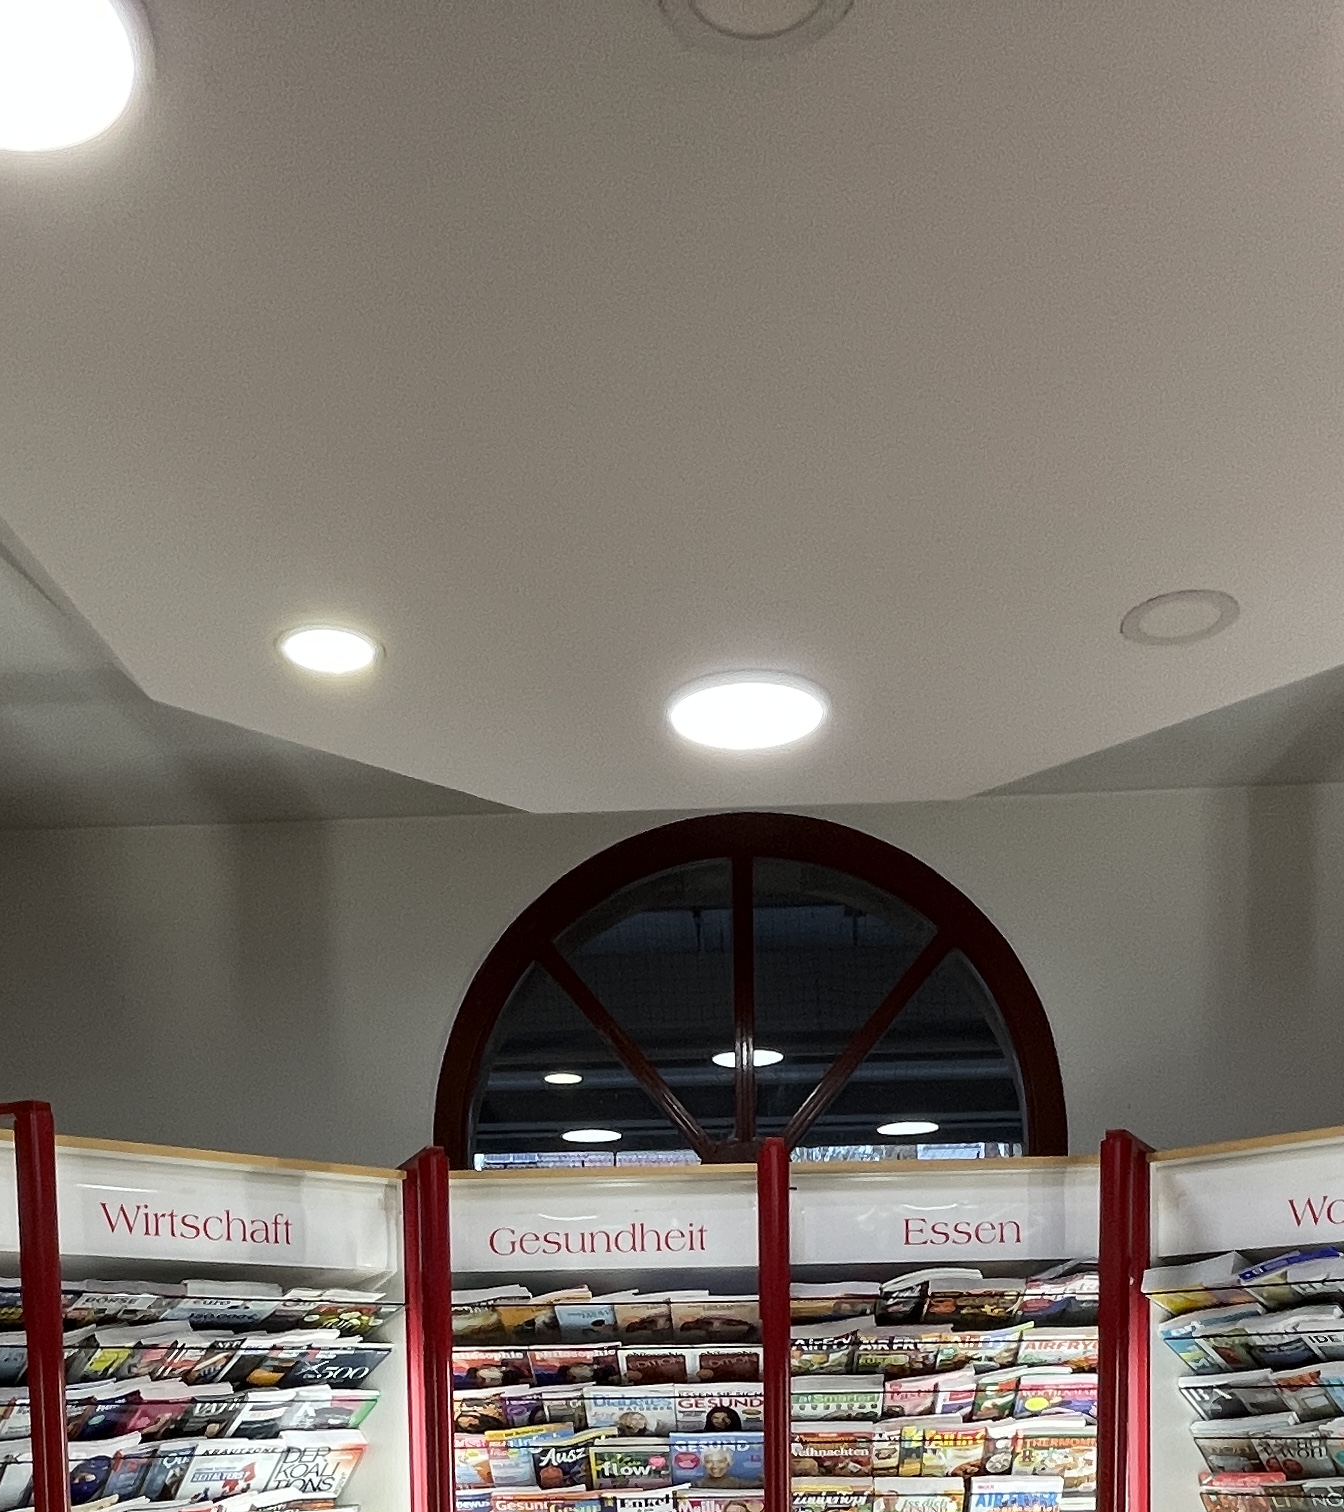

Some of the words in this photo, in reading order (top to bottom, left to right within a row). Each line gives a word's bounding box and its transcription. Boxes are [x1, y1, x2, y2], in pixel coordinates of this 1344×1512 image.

[100, 1201, 293, 1245] Wirtschaft
[904, 1218, 1022, 1245] Essen
[489, 1223, 708, 1256] Gesundheit
[602, 1457, 653, 1478] flow
